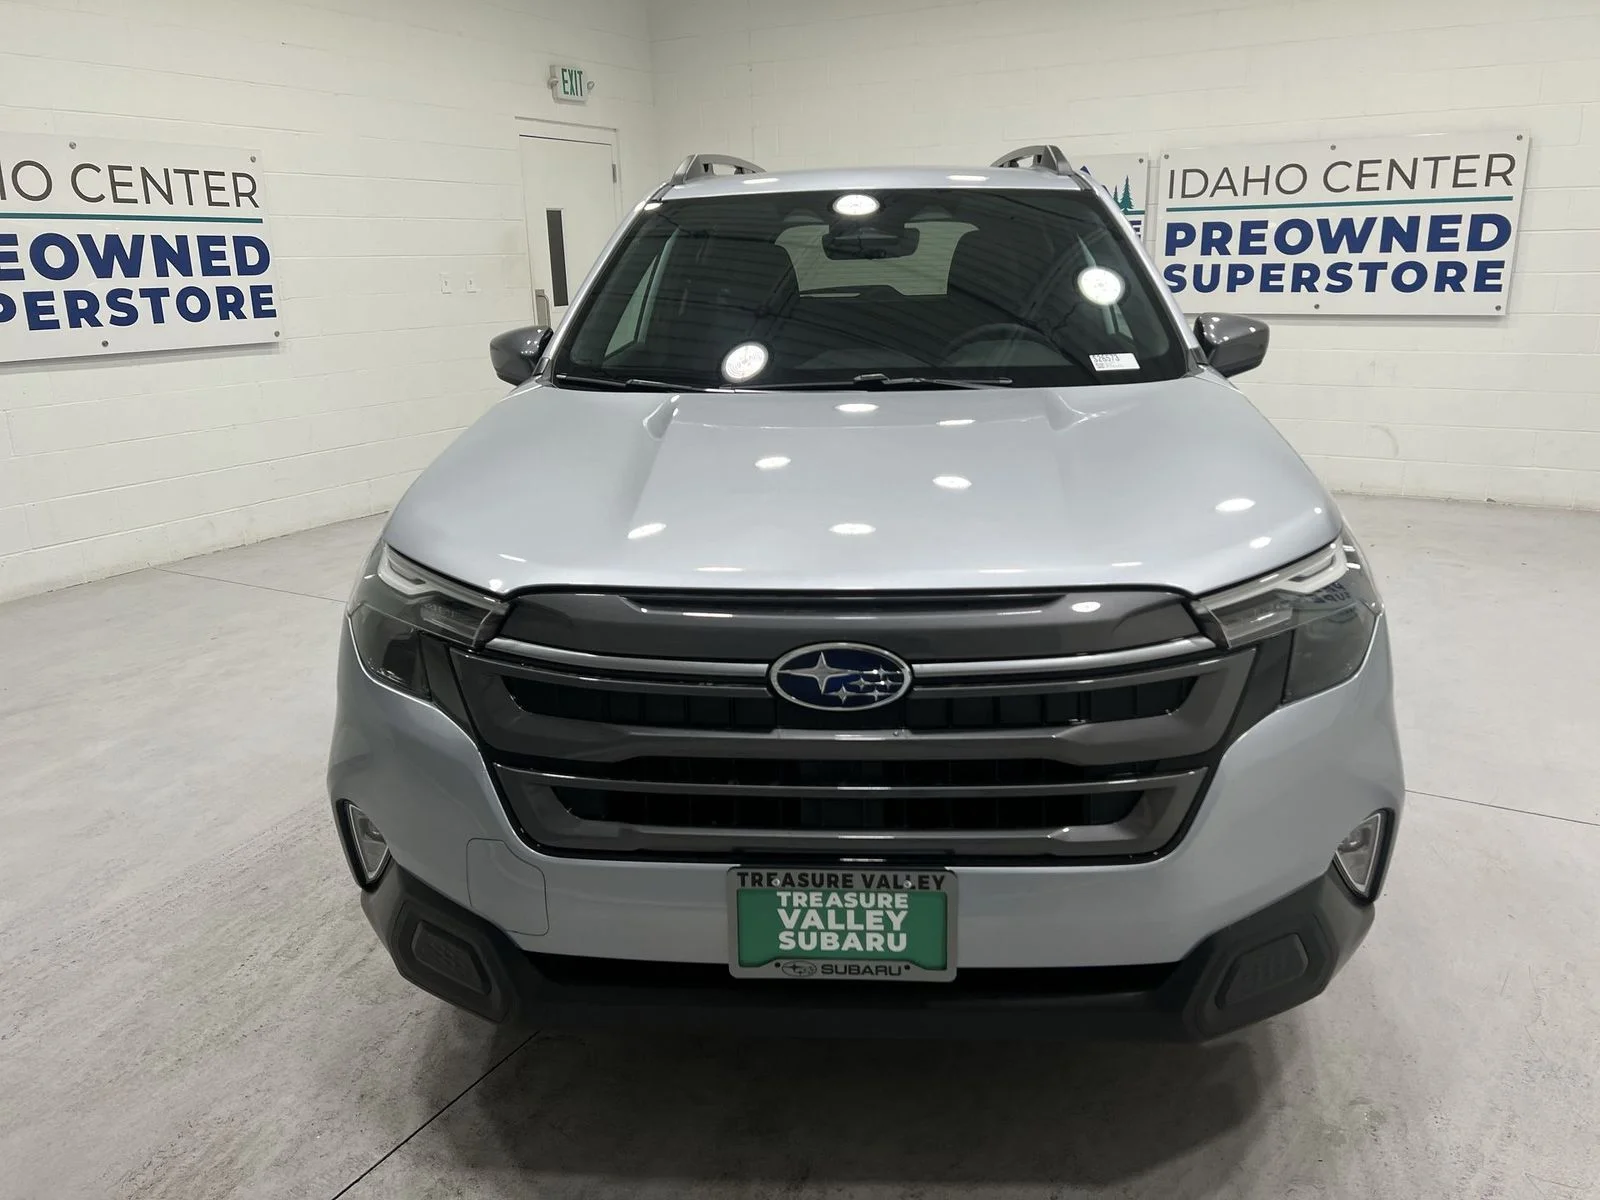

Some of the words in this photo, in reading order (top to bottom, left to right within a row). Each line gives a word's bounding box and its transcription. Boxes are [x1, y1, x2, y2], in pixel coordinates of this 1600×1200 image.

[561, 68, 583, 96] EXIT
[0, 160, 52, 202] O
[71, 163, 260, 208] CENTER
[1168, 163, 1308, 199] IDAHO
[1322, 153, 1516, 193] CENTER
[1165, 213, 1512, 256] PREOWNED
[1163, 260, 1506, 293] SUPERSTORE
[737, 871, 854, 889] TREASURE
[861, 873, 945, 890] VALLEY
[776, 891, 909, 909] TREASURE
[776, 908, 909, 931] VALLEY
[778, 931, 907, 952] SUBARU
[821, 963, 902, 976] SUBARU
